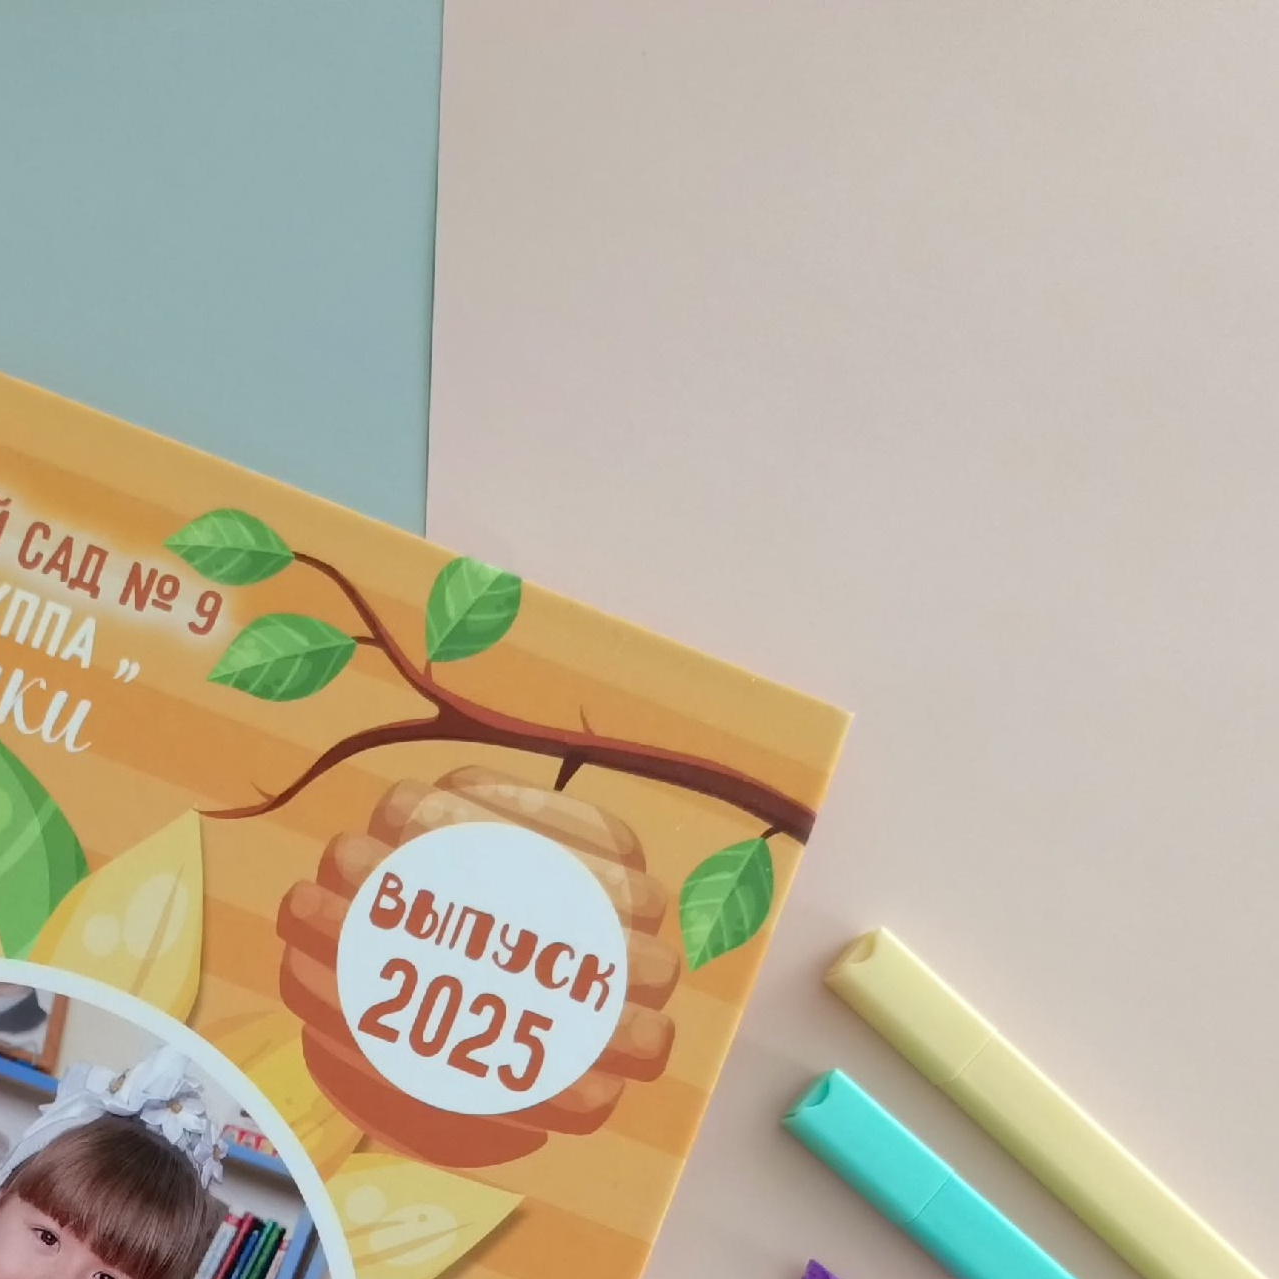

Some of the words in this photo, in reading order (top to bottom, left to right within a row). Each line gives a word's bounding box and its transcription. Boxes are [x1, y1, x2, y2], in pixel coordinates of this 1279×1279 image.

[17, 520, 110, 599] САД
[118, 561, 180, 612] №
[187, 590, 224, 635] 9
[357, 957, 554, 1092] 2025
